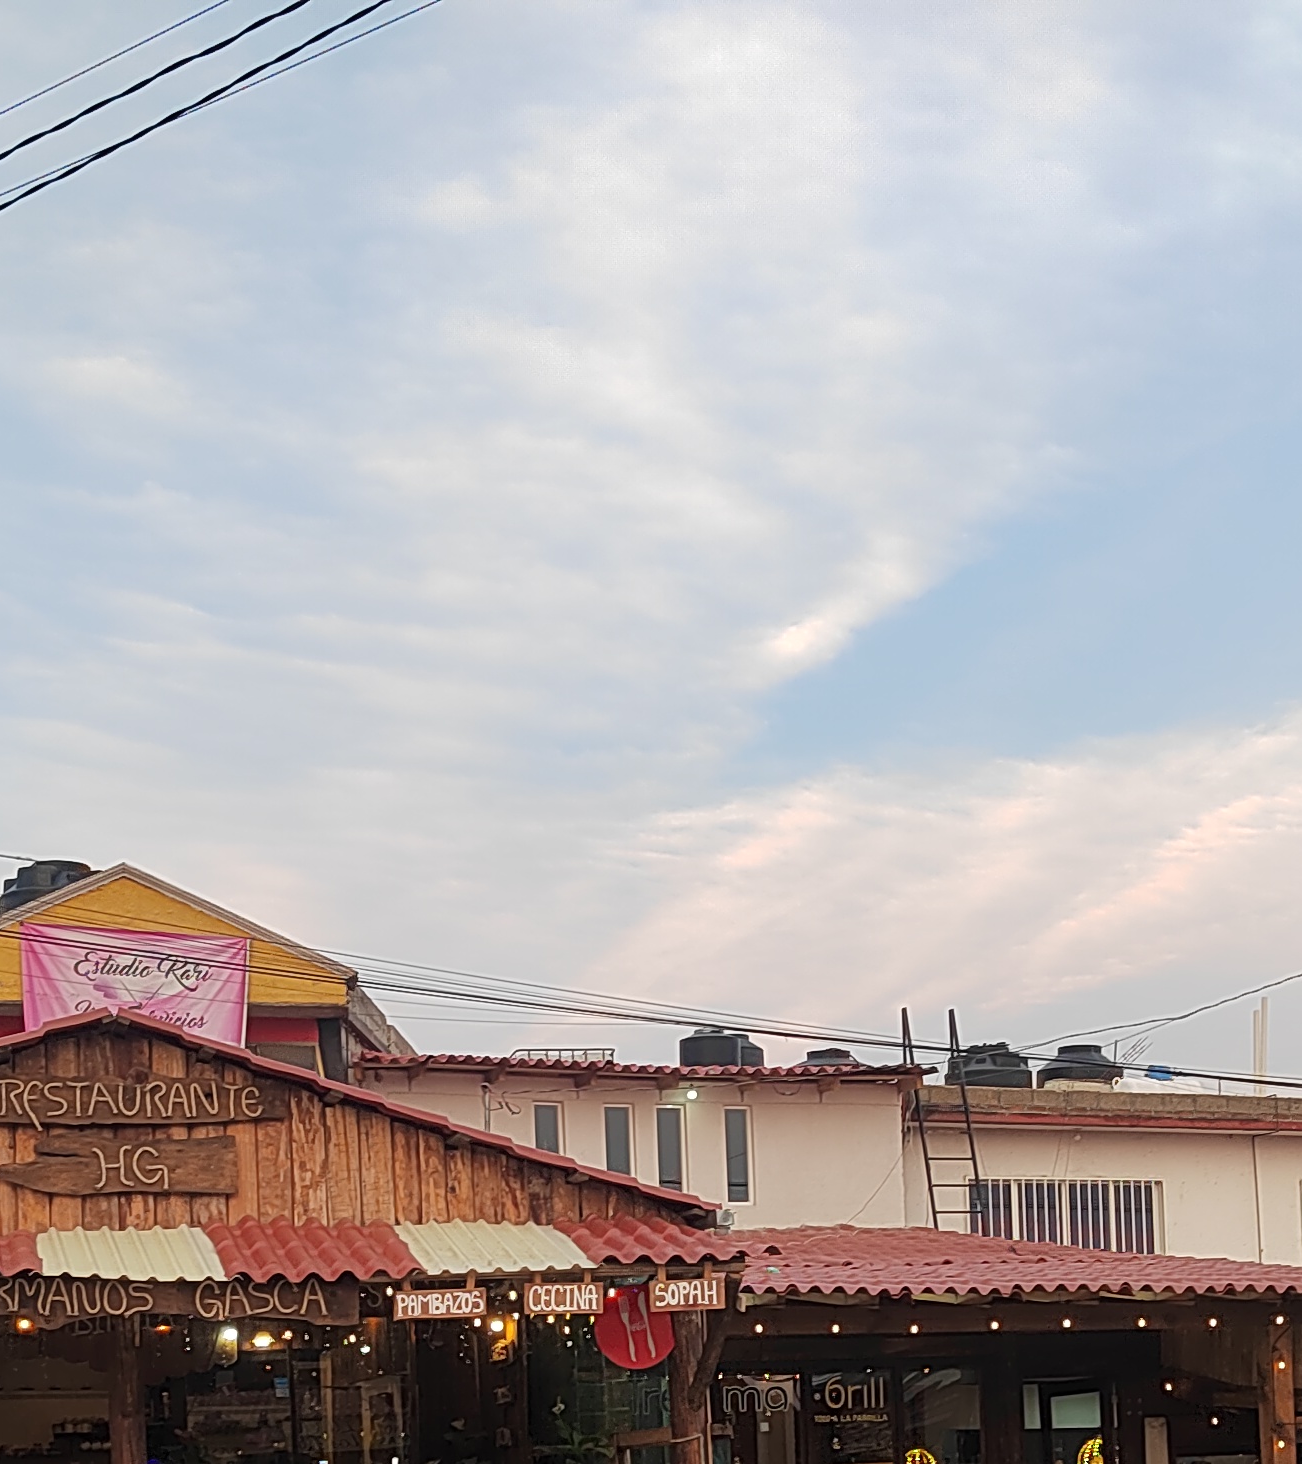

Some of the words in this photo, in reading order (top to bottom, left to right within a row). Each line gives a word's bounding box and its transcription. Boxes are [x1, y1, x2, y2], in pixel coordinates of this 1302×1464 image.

[73, 951, 153, 982] Estudio
[92, 1145, 170, 1189] HG
[196, 1279, 330, 1321] GASCA
[397, 1291, 486, 1316] PAMBAZOS
[528, 1284, 598, 1312] CECINA
